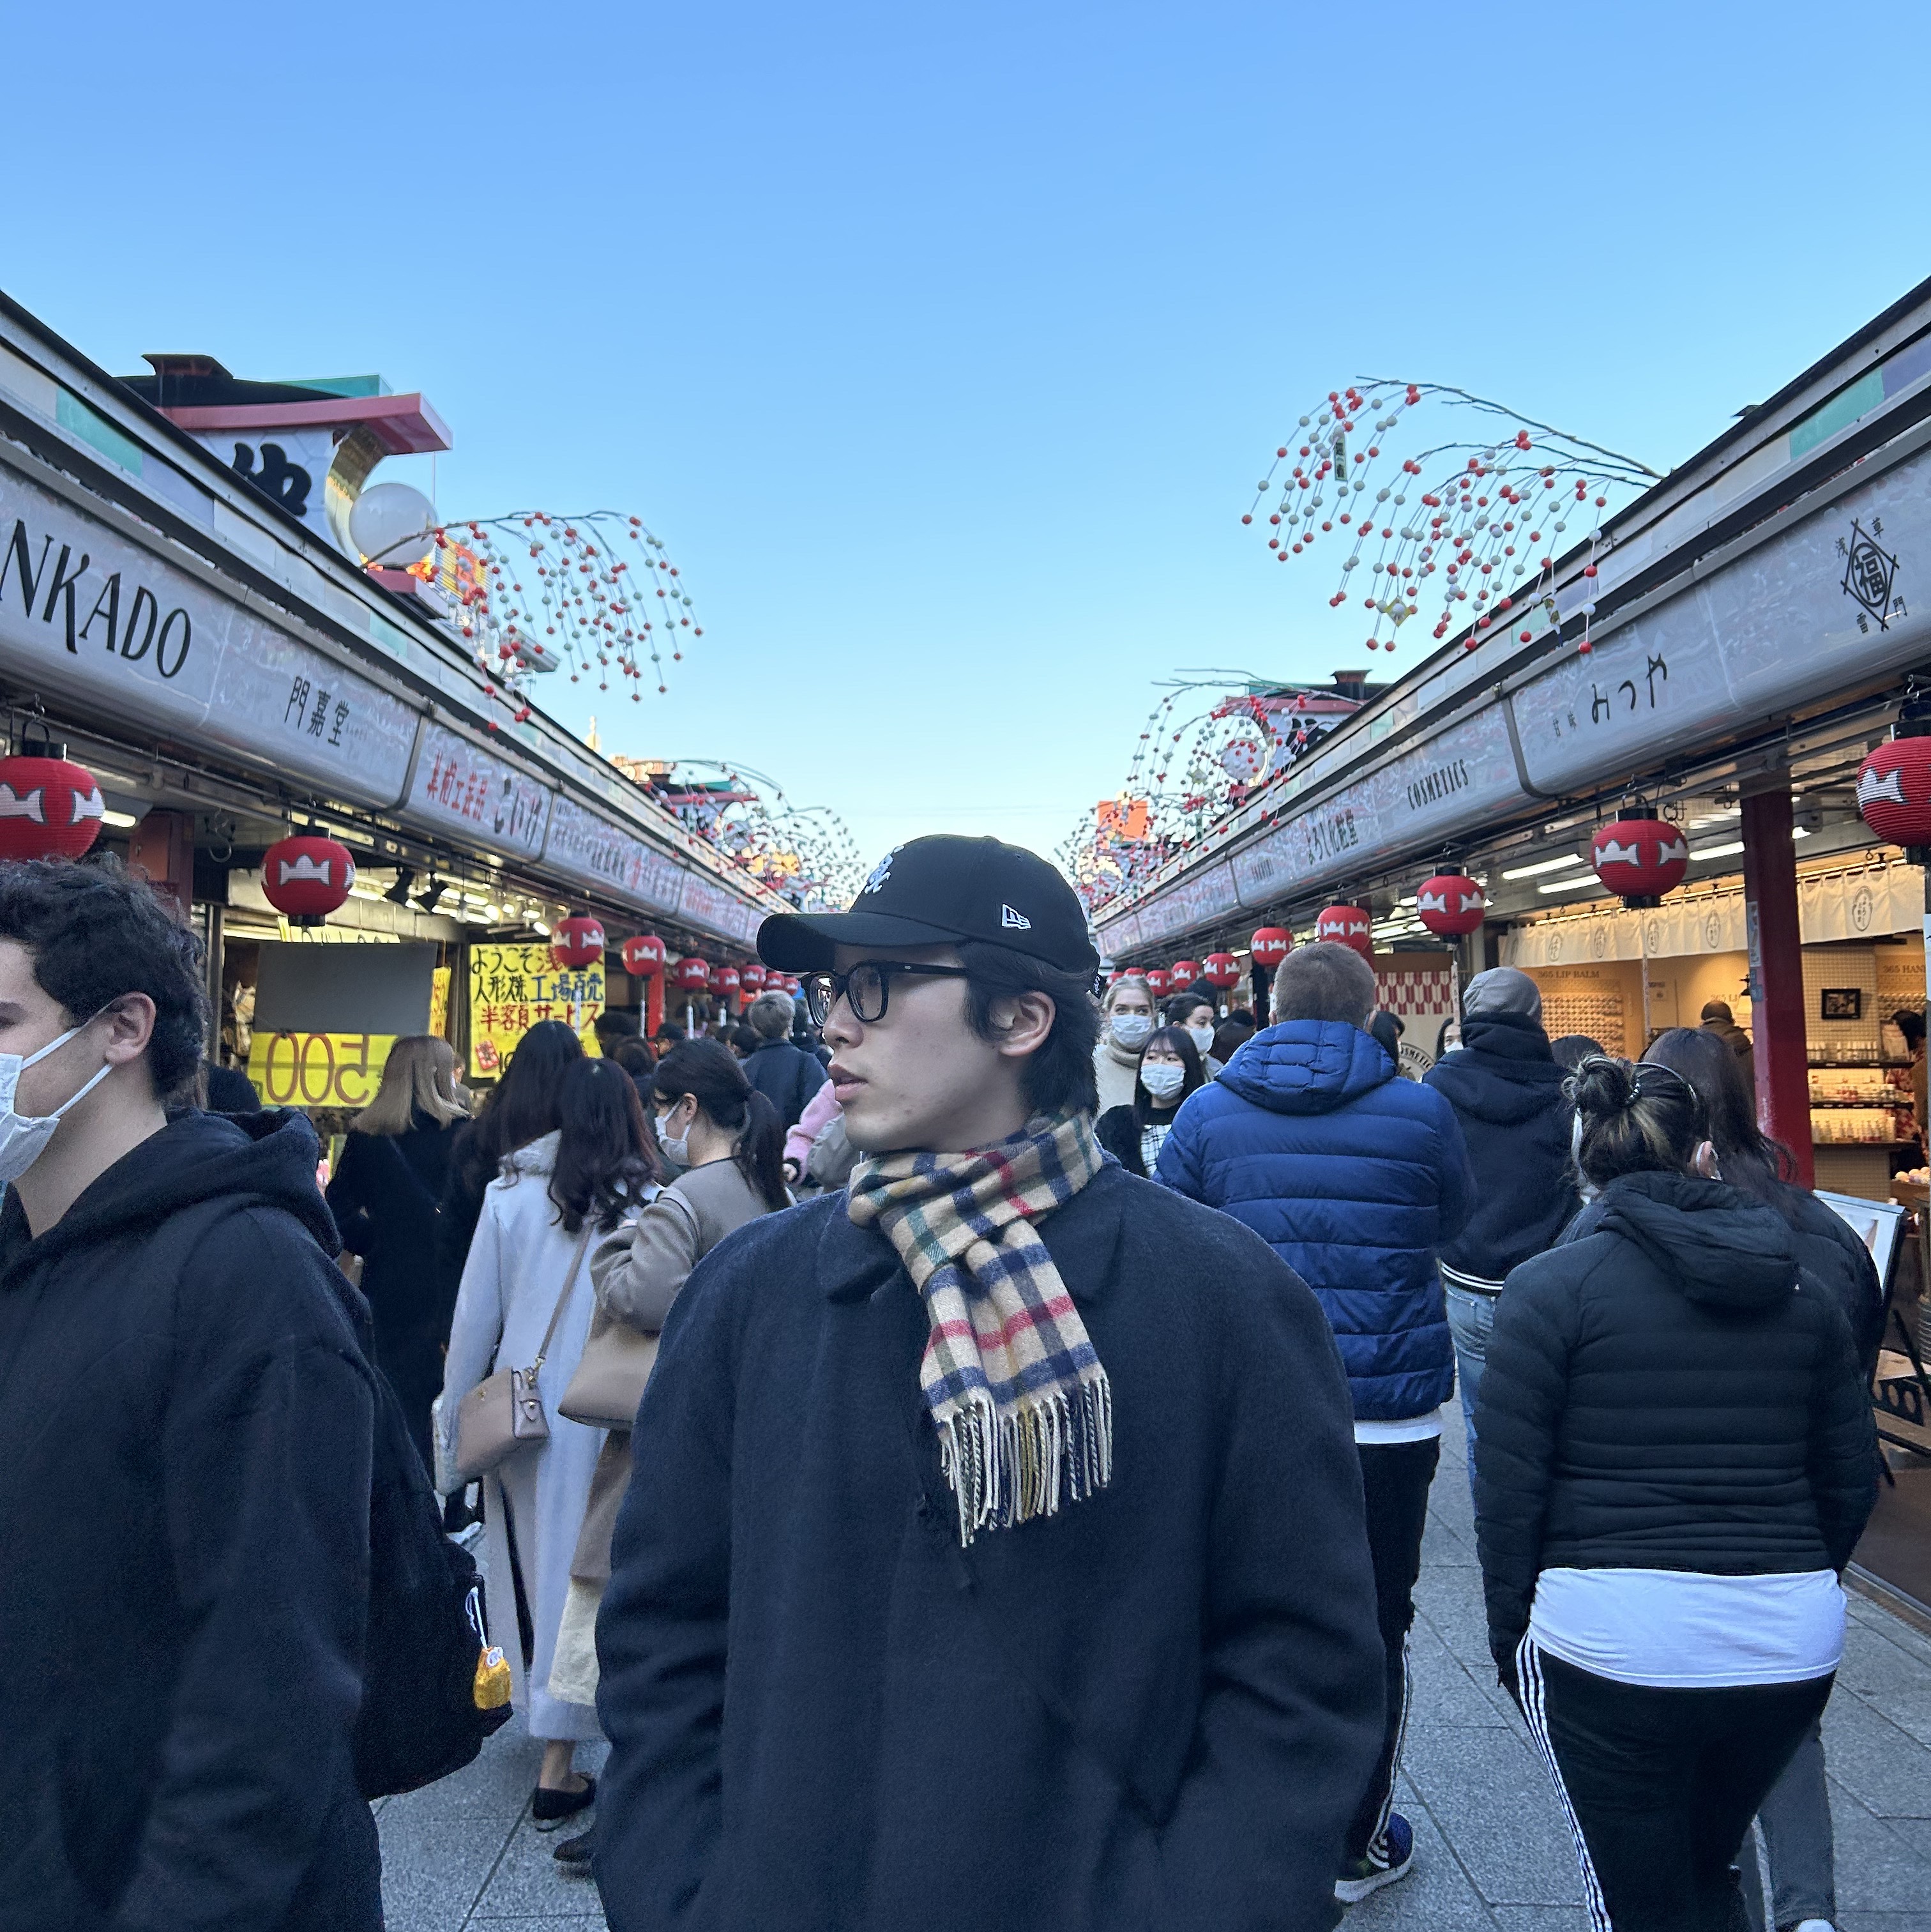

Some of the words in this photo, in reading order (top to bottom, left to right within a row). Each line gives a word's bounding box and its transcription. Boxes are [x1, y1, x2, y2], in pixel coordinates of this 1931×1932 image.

[0, 519, 191, 678] NKADO
[1854, 550, 1884, 600] 福
[284, 676, 350, 747] 門嘉堂
[1592, 653, 1667, 724] みつや
[1407, 758, 1469, 810] COSMETICS
[1556, 970, 1571, 978] LIP
[1573, 970, 1600, 978] BALM
